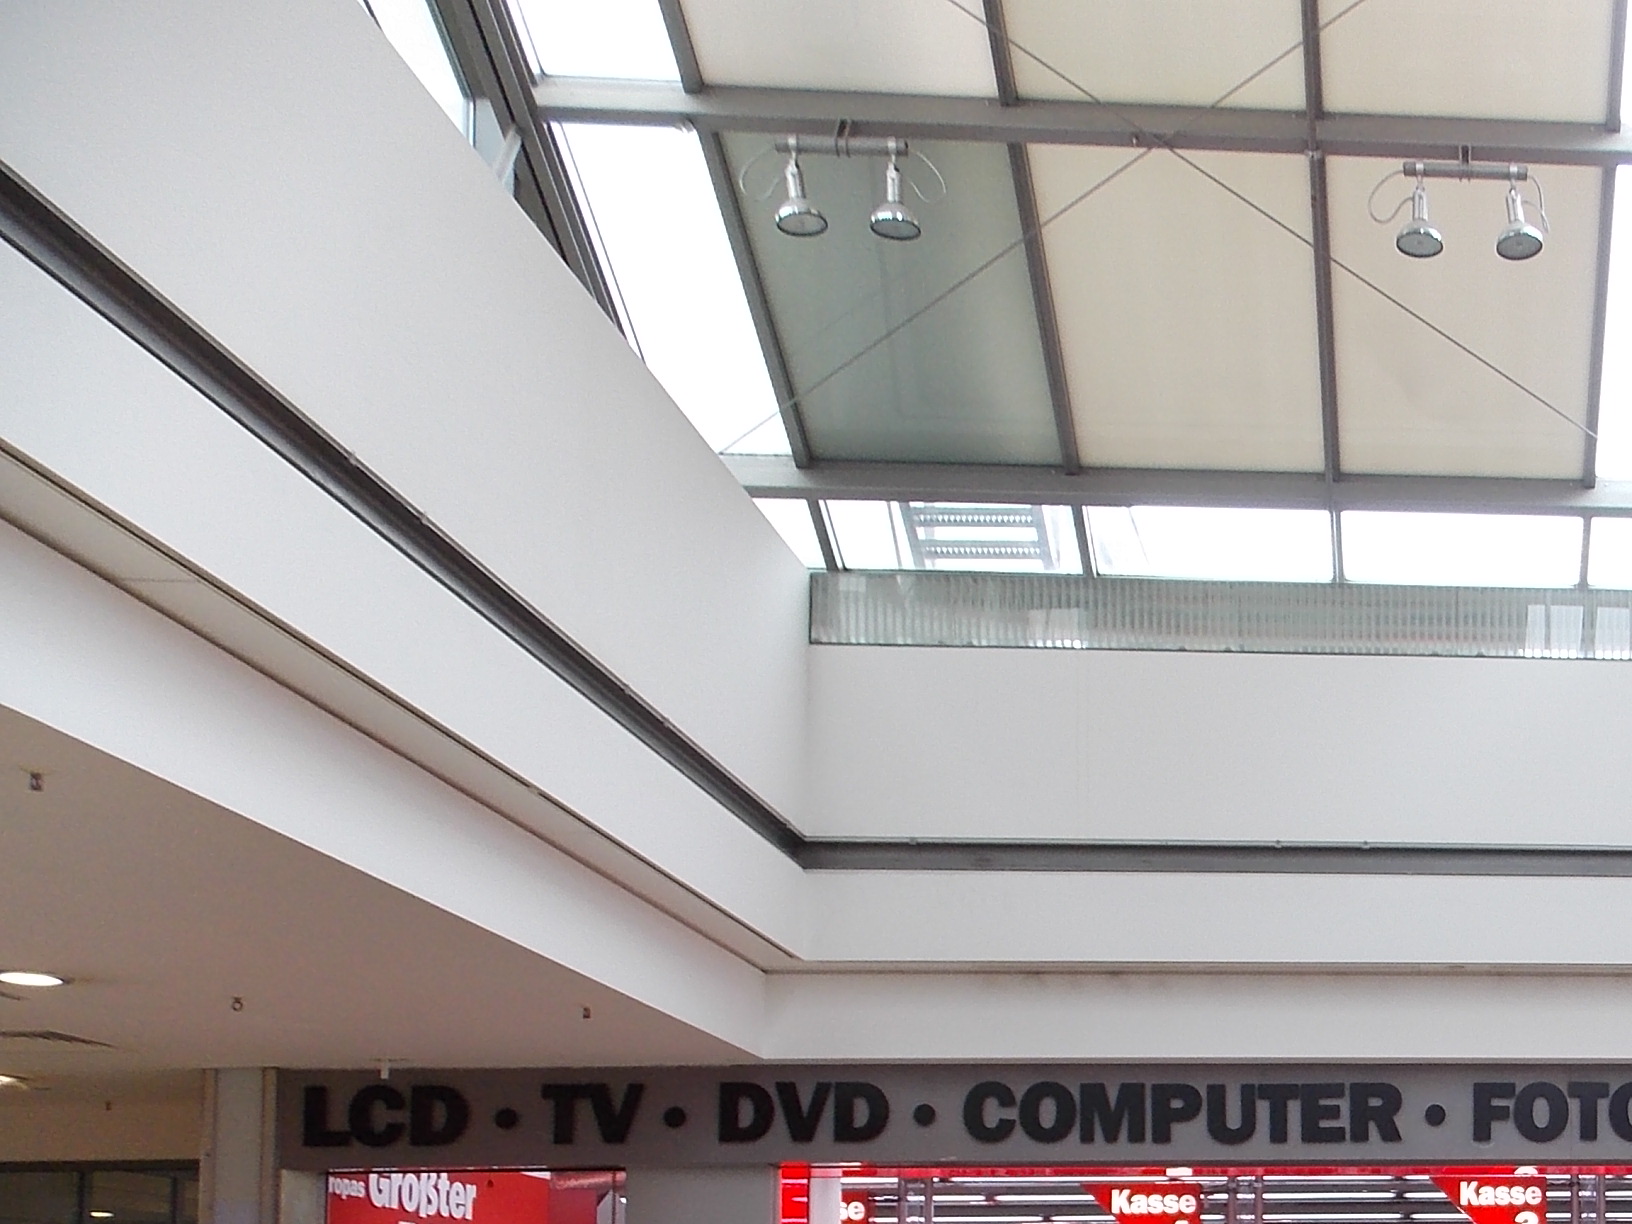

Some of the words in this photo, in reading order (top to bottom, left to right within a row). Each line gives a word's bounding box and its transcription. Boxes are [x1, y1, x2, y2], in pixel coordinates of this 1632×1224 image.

[302, 1085, 469, 1146] LCD
[541, 1083, 646, 1143] TV
[717, 1082, 891, 1142] DVD
[962, 1081, 1404, 1143] COMPUTER
[1110, 1187, 1197, 1217] Kasse
[1459, 1179, 1543, 1208] Kasse
